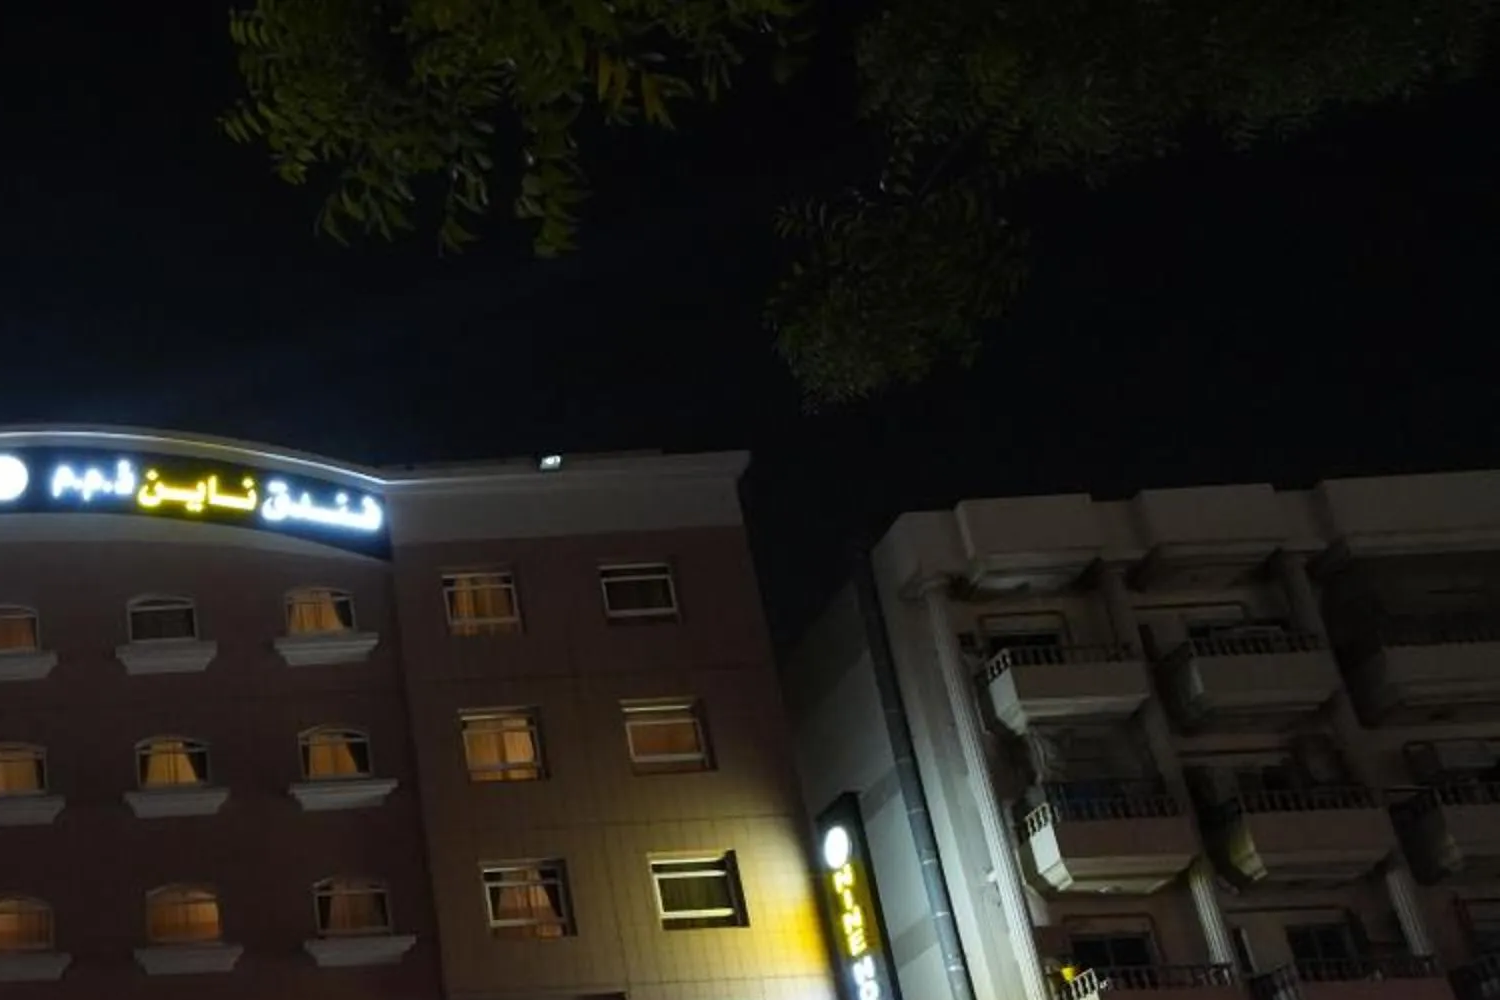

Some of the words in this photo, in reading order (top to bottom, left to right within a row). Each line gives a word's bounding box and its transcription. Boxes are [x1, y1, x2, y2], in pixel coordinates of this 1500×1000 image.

[137, 469, 258, 511] ناين
[261, 479, 384, 531] فندق
[832, 863, 867, 956] NINE
